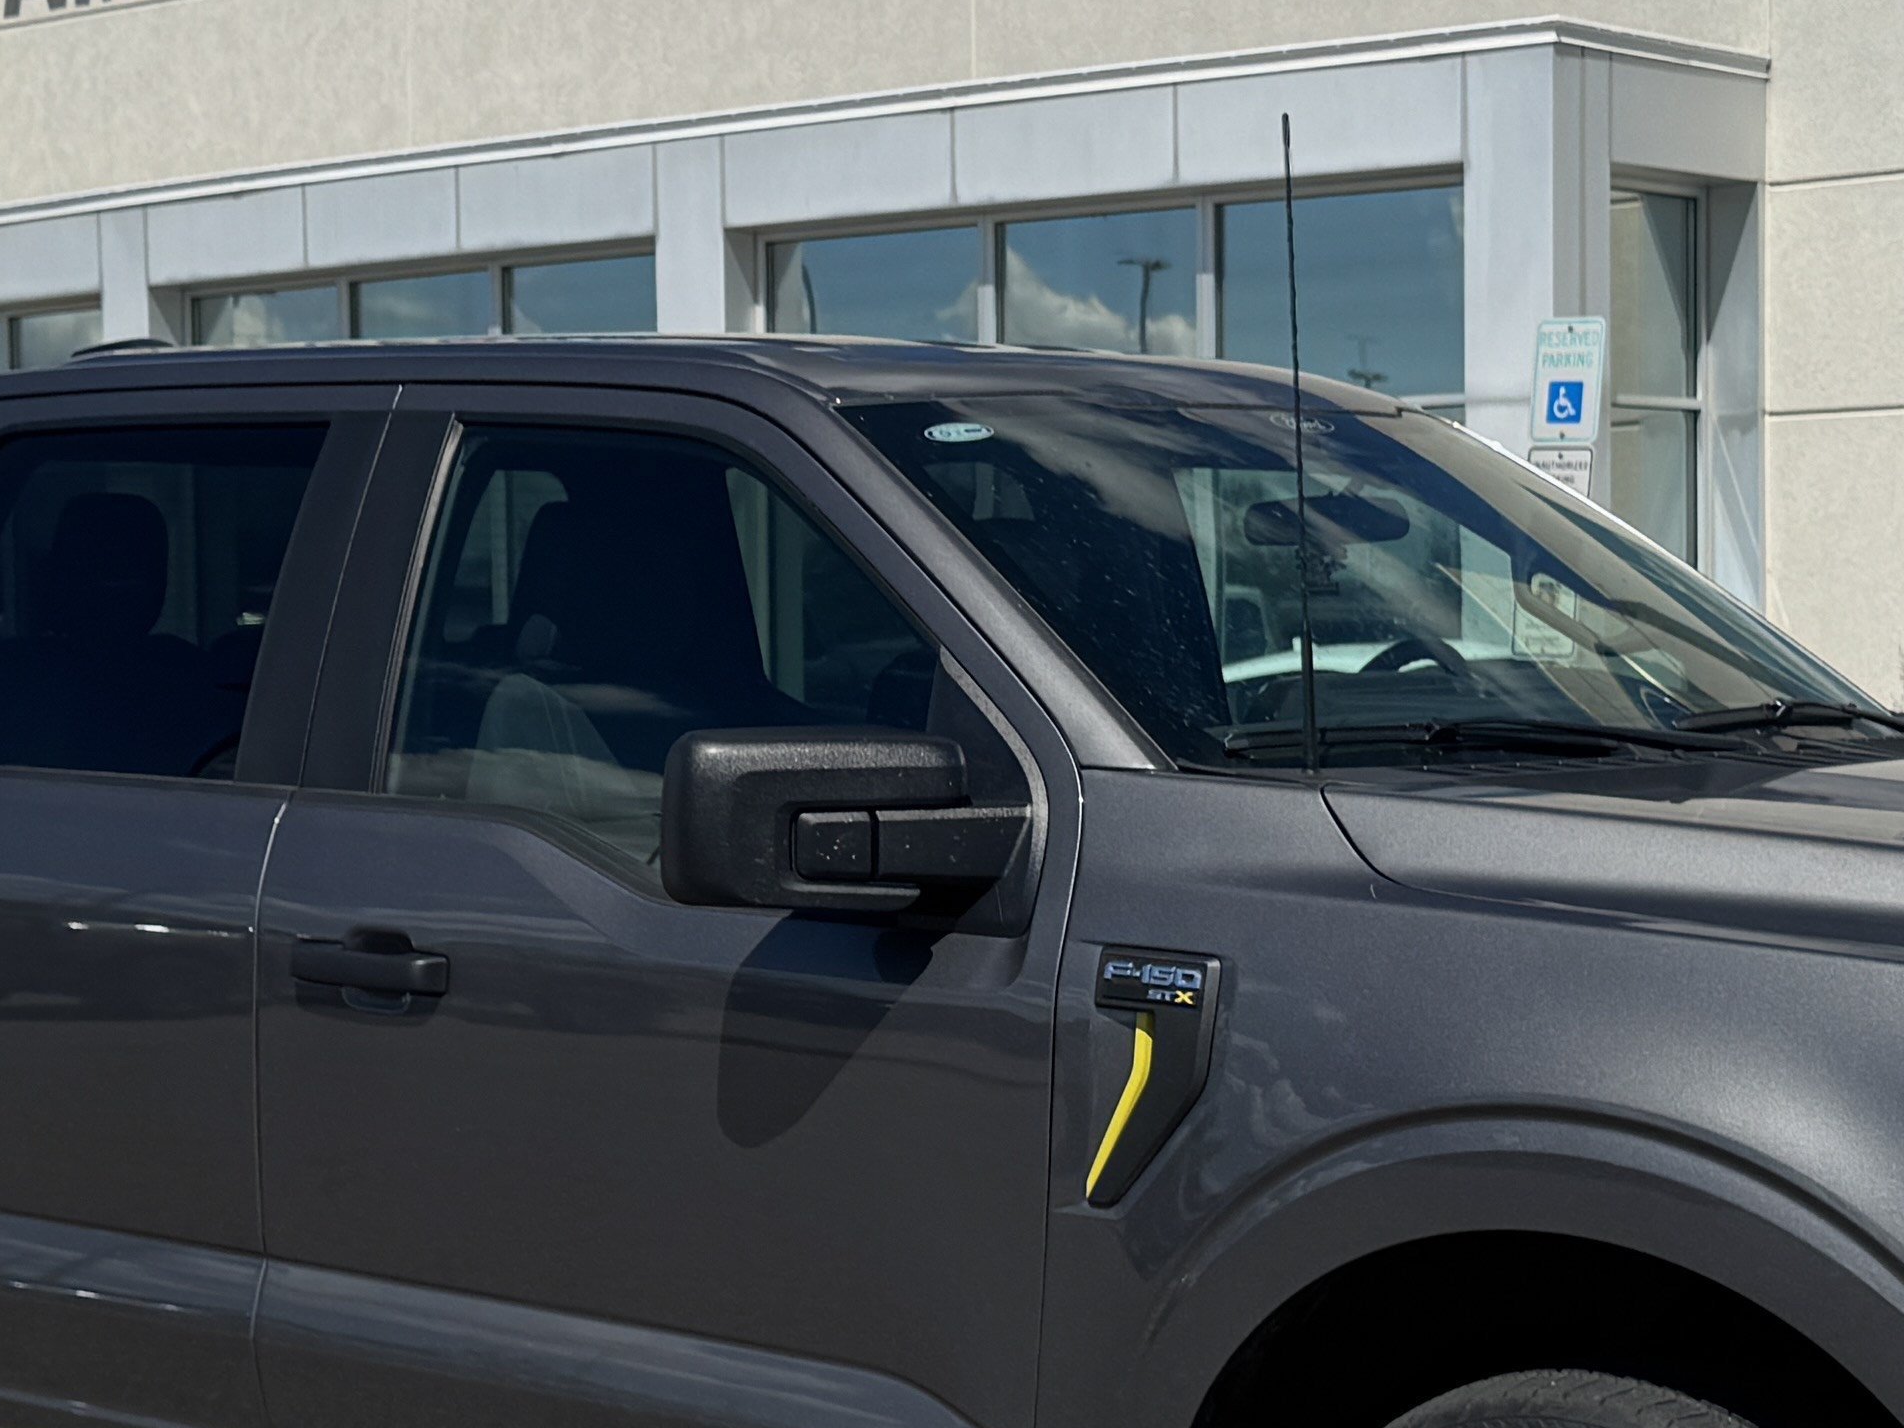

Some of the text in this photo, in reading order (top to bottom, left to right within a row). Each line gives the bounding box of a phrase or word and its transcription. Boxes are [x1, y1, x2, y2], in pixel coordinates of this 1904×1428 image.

[1538, 330, 1599, 348] RESERVED
[1541, 351, 1594, 368] PARKING
[1533, 460, 1589, 471] NAUTHORIZED
[1103, 961, 1202, 990] F-150
[1146, 989, 1194, 1005] STX
